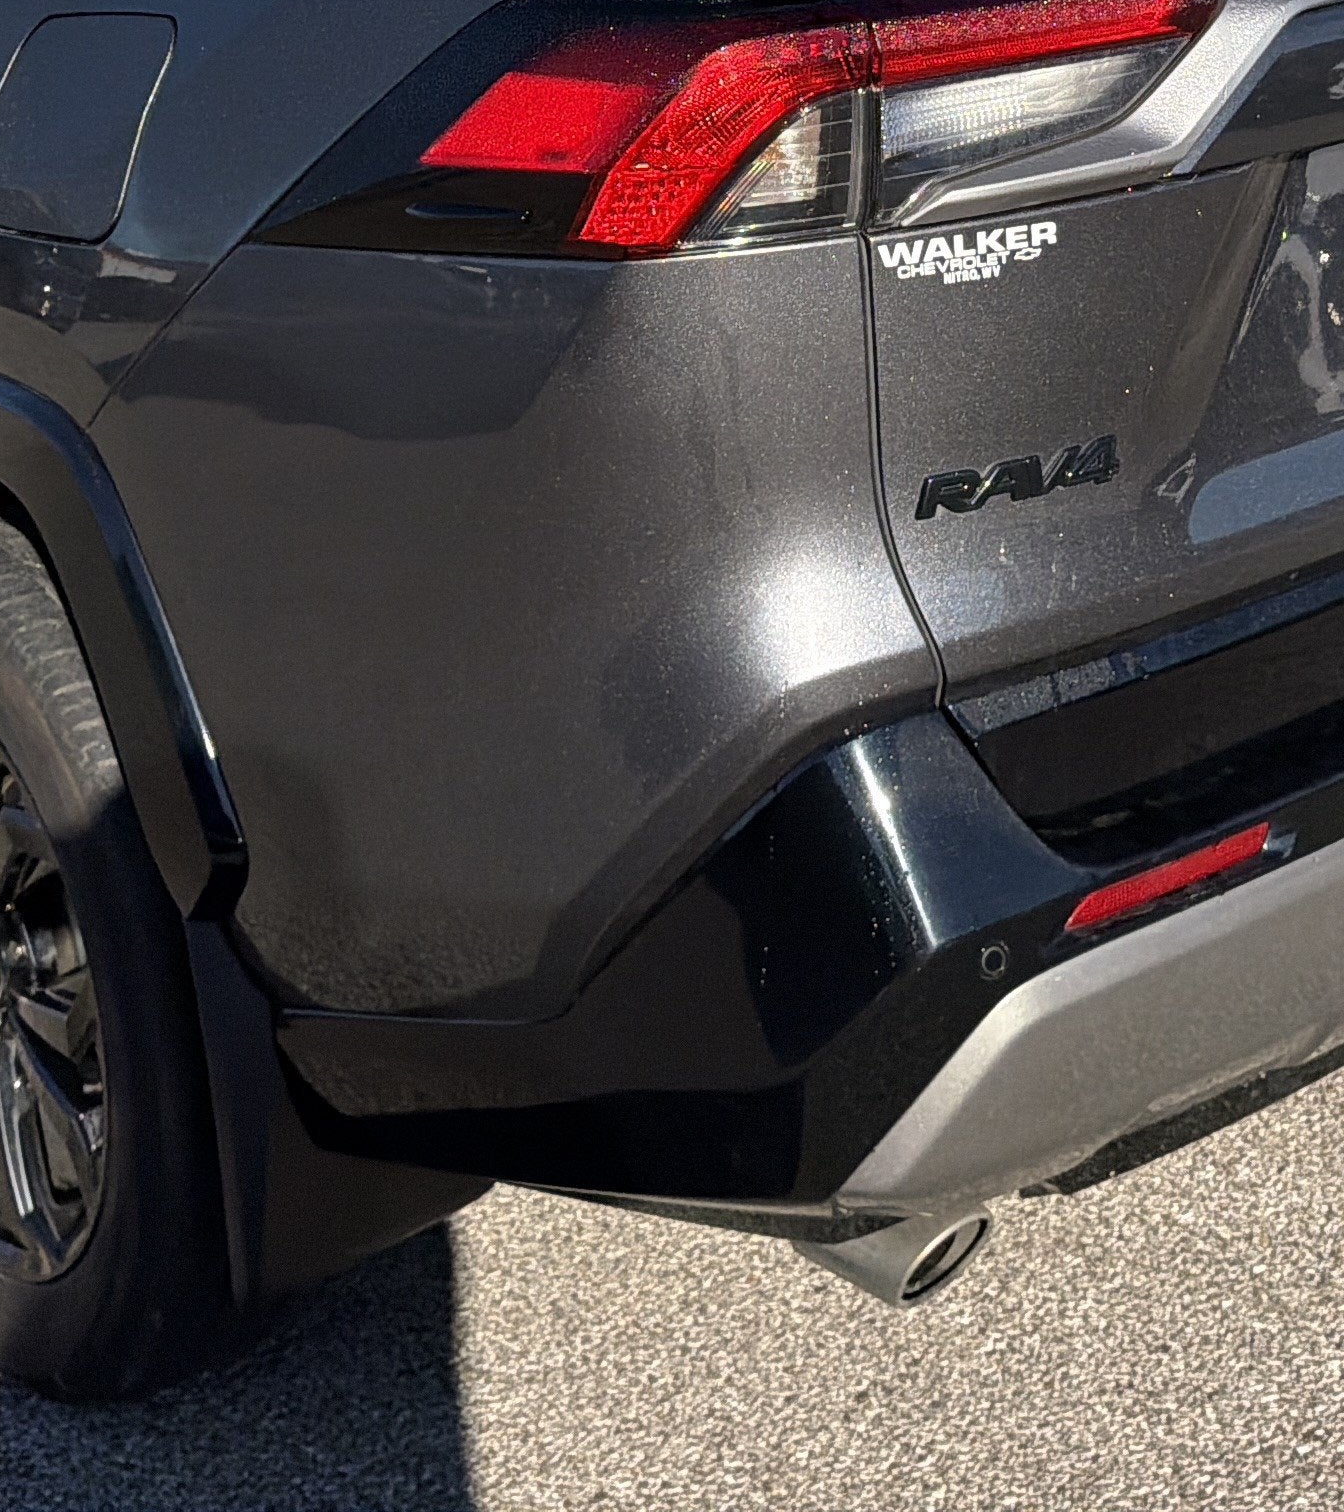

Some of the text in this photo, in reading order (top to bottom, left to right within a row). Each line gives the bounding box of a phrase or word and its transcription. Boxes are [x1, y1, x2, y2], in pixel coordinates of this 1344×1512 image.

[877, 221, 1057, 268] WALKER
[897, 251, 1010, 280] CHEVROLET
[982, 265, 1001, 279] WV
[914, 434, 1121, 521] RAV4
